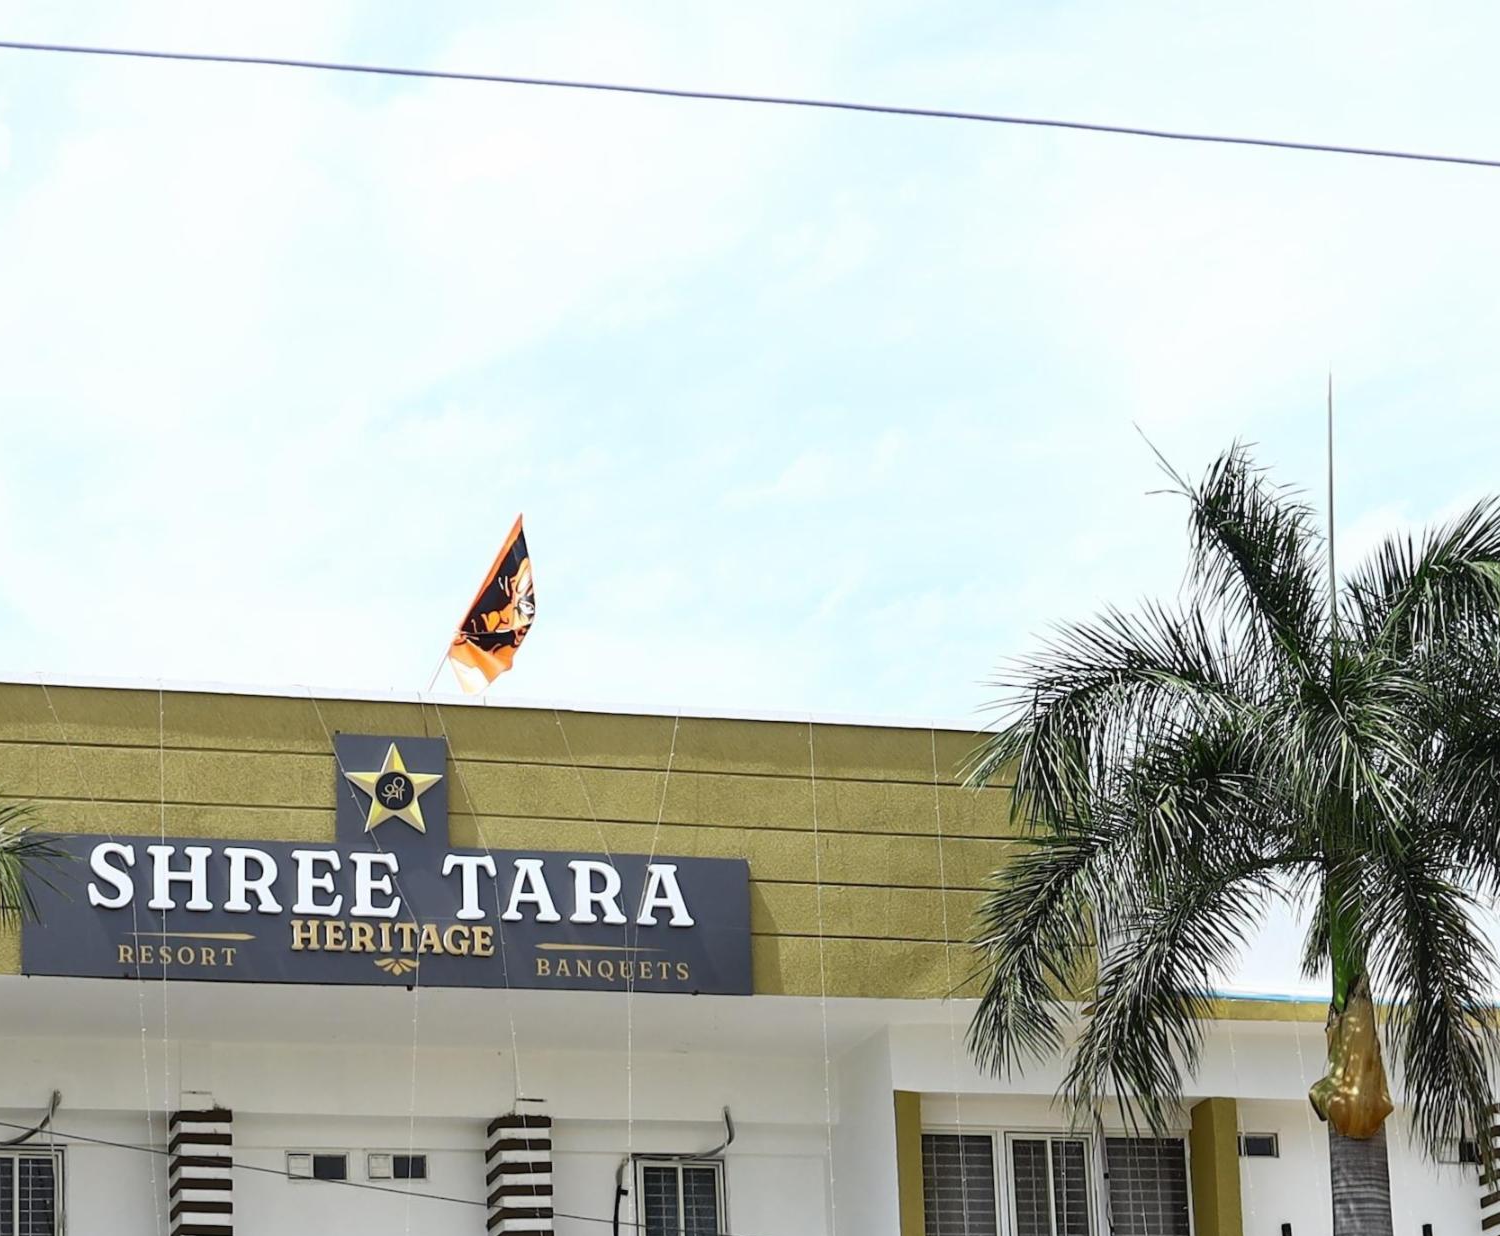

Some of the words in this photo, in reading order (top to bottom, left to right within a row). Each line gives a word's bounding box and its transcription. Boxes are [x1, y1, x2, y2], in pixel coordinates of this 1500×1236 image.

[87, 842, 402, 918] SHREE
[441, 854, 695, 927] TARA
[290, 919, 495, 957] HERITAGE
[117, 944, 237, 966] RESORT
[536, 958, 690, 980] BANQUETS
